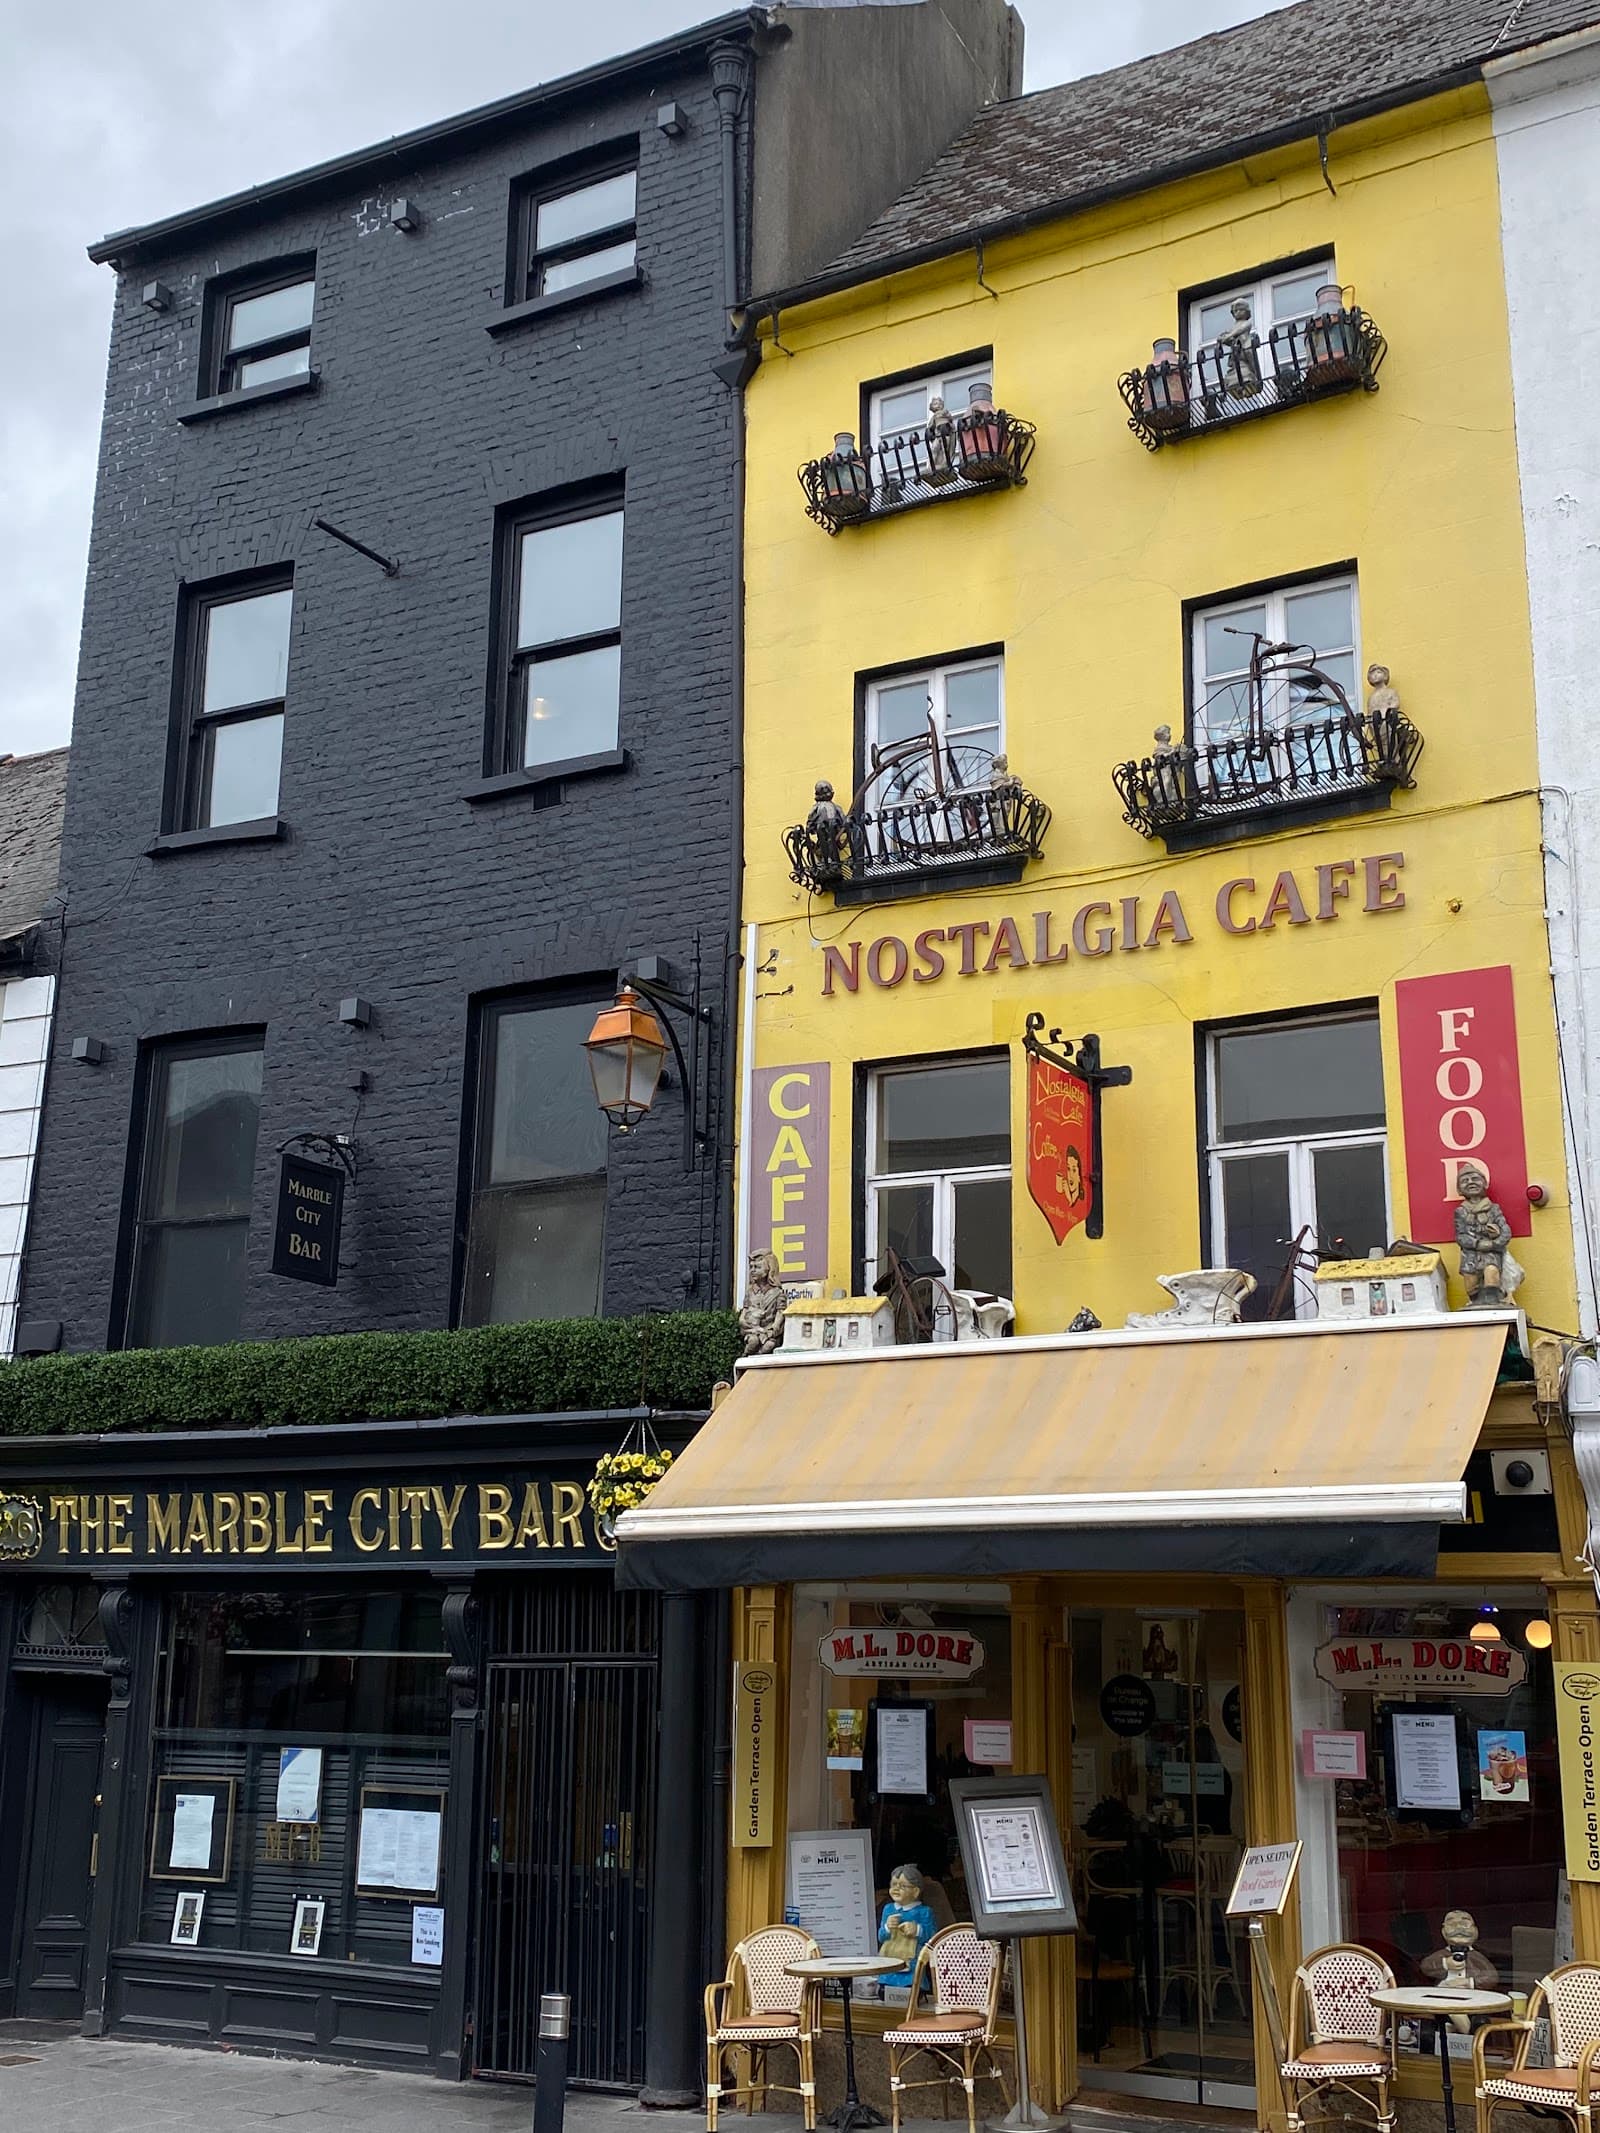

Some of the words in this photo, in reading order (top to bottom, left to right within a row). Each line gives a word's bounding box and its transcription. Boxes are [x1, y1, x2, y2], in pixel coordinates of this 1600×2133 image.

[821, 890, 1193, 996] NOSTALGIA
[1216, 852, 1406, 934] CAFE
[1035, 1066, 1085, 1106] Nostalgia
[1061, 1094, 1083, 1124] Cafe
[766, 1073, 812, 1273] CAFE
[49, 1494, 134, 1554] THE
[146, 1490, 334, 1554] MARBLE
[348, 1484, 468, 1552] CITY
[477, 1481, 586, 1550] BAR
[832, 1633, 888, 1662] M.L.
[896, 1632, 975, 1665] DORE
[913, 1661, 938, 1669] CAFE
[1331, 1642, 1402, 1674] M.L.
[1412, 1641, 1512, 1678] DORE
[751, 1698, 763, 1734] Open
[1579, 1705, 1594, 1748] Open
[750, 1737, 760, 1785] Terrace
[1582, 1751, 1596, 1809] Terrace
[749, 1787, 760, 1838] Garden
[1245, 1855, 1264, 1865] OPEN
[1265, 1851, 1294, 1863] SEATIN
[1585, 1812, 1600, 1871] Garden
[1241, 1878, 1259, 1892] Roof
[1260, 1875, 1283, 1890] Garden
